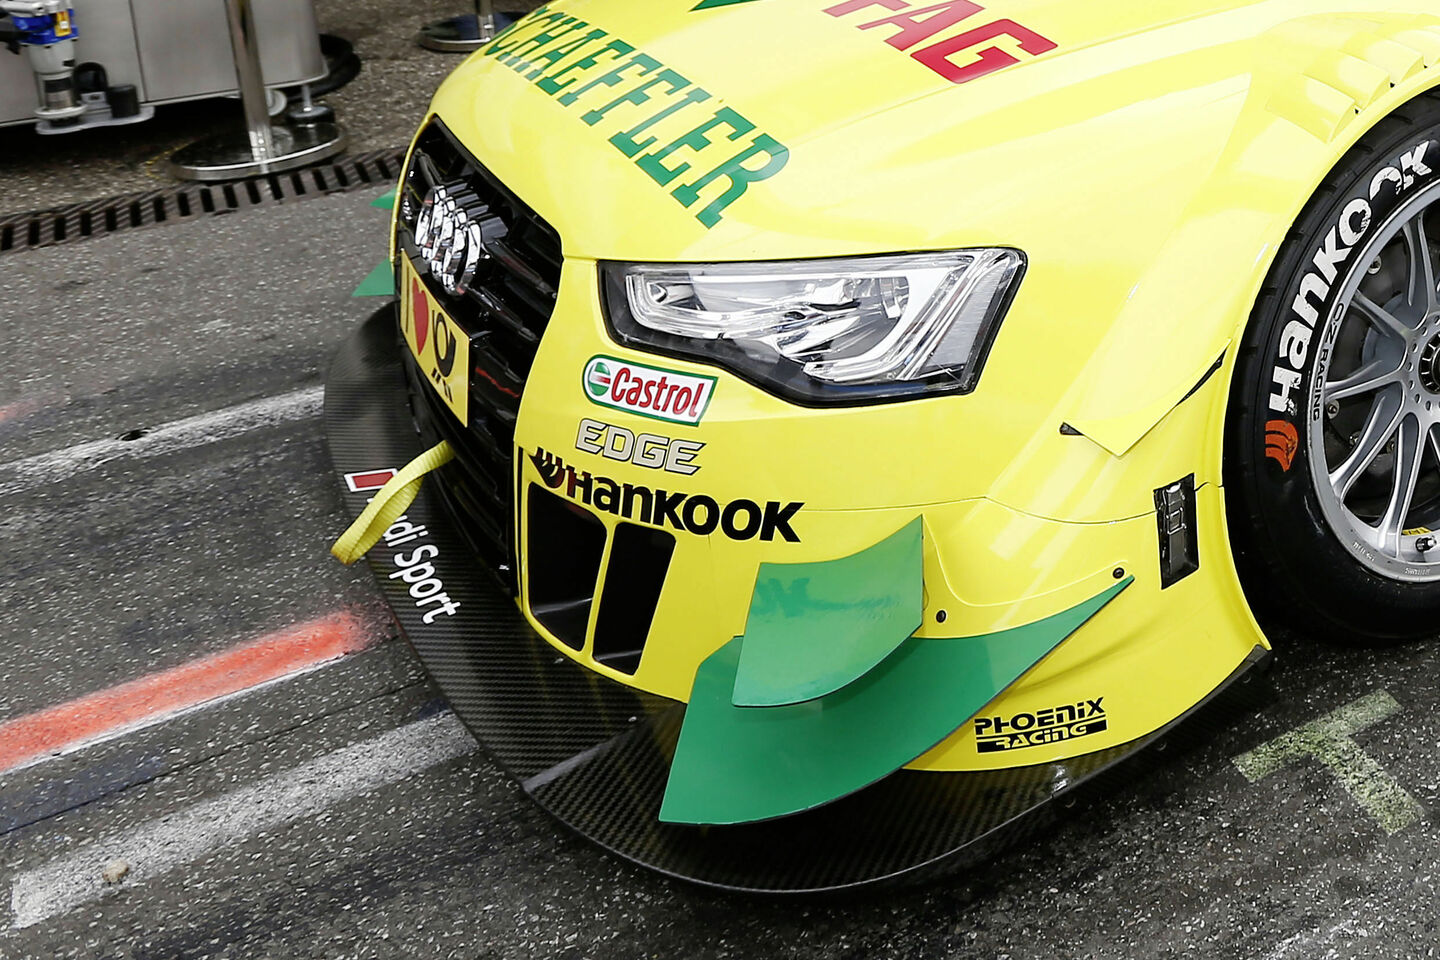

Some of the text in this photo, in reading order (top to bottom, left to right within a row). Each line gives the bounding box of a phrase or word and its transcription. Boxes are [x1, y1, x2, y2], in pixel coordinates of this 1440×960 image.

[610, 367, 705, 418] Castrol
[1312, 349, 1329, 421] RACING
[575, 418, 707, 476] EDGE
[388, 544, 461, 625] Sport
